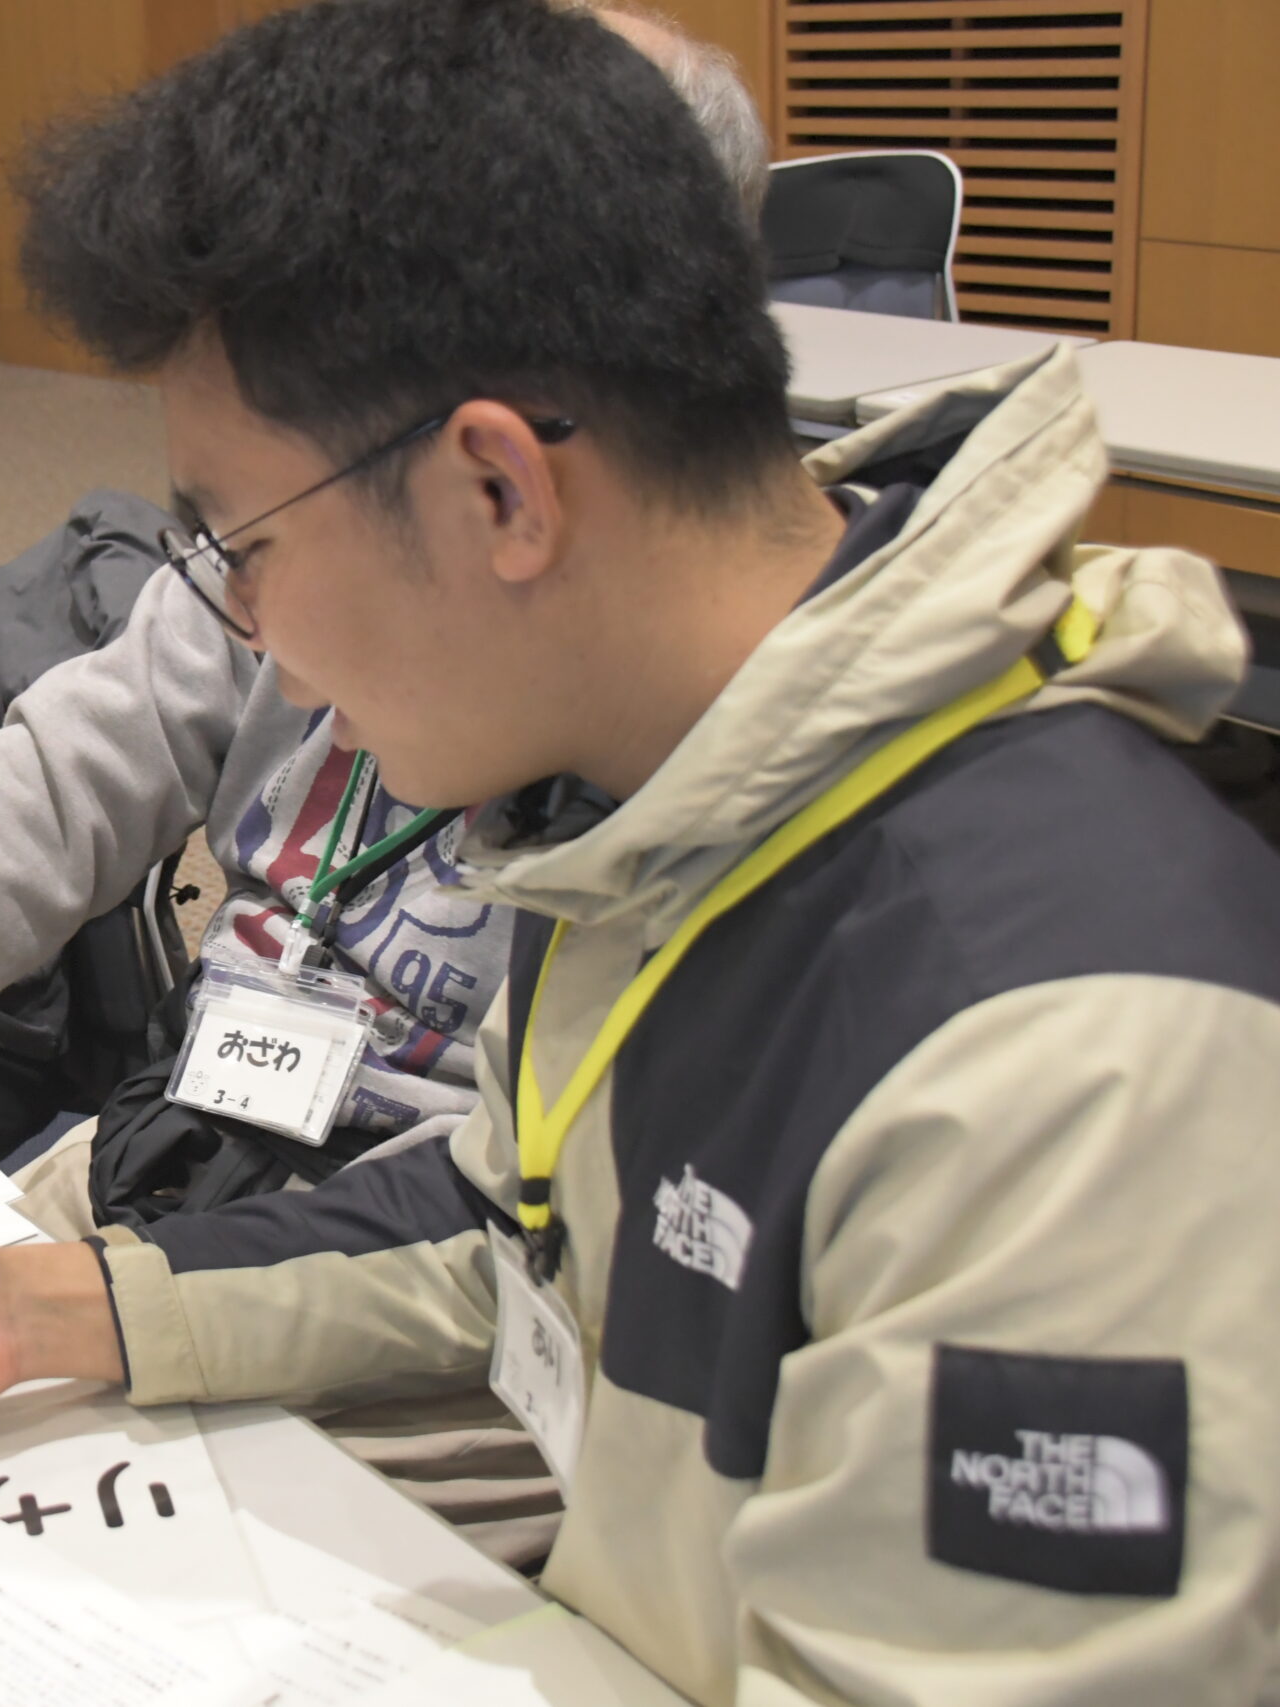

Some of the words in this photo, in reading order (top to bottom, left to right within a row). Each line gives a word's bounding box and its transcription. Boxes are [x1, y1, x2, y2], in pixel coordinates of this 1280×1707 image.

[391, 950, 478, 1034] 95
[217, 1030, 301, 1073] おざわ
[1014, 1428, 1094, 1464] THE
[951, 1448, 1093, 1496] NORTH
[987, 1484, 1094, 1533] FACE
